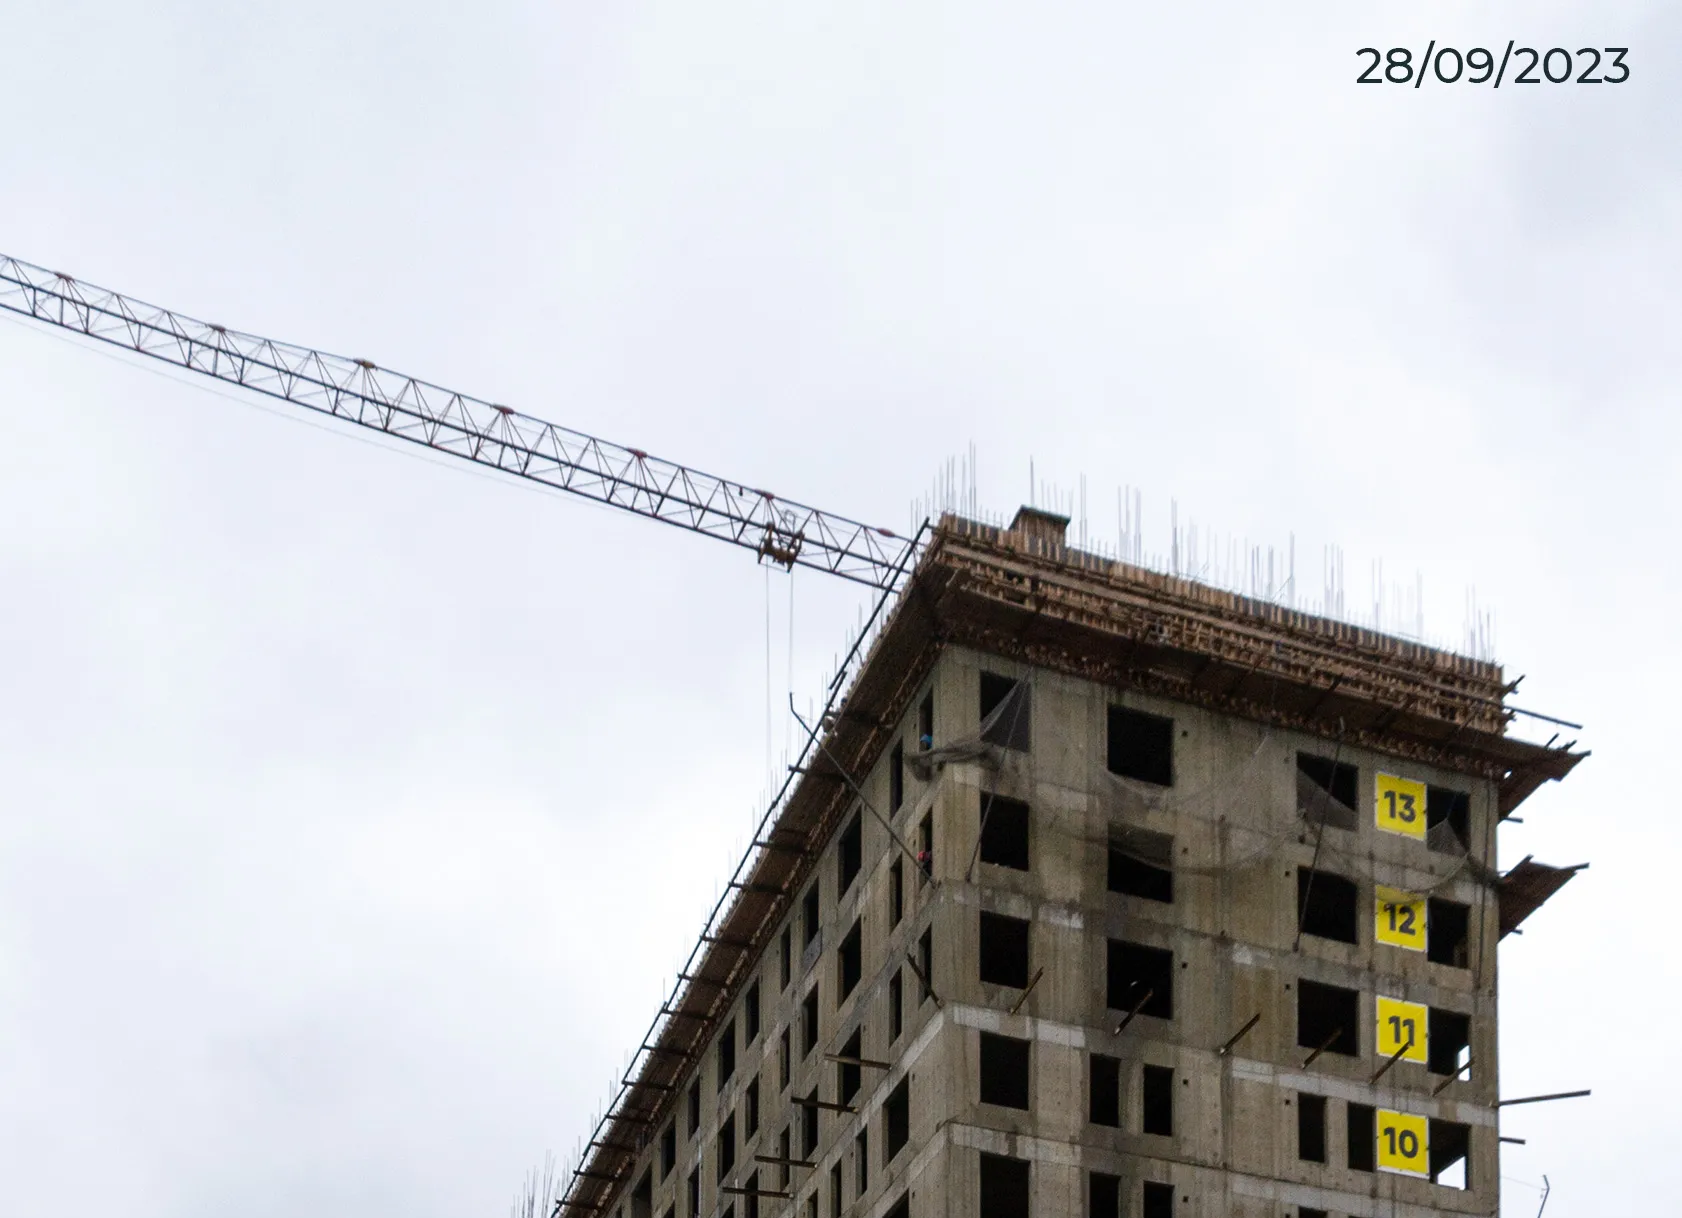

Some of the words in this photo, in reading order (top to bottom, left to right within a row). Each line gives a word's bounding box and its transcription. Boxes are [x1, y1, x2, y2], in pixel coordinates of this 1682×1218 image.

[1383, 789, 1416, 823] 13
[1383, 903, 1416, 936] 12
[1388, 1015, 1415, 1047] 11
[1383, 1126, 1419, 1159] 10
